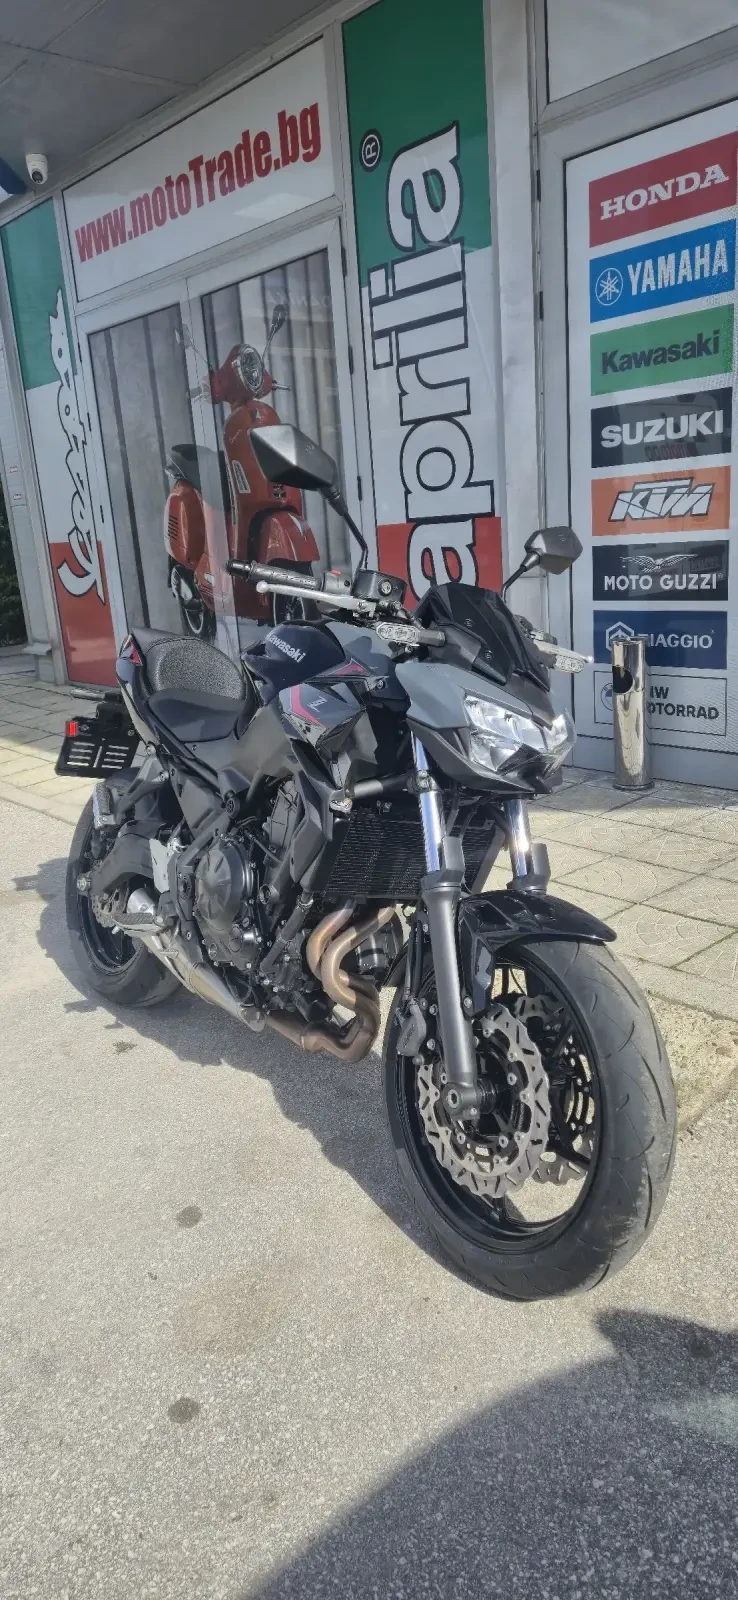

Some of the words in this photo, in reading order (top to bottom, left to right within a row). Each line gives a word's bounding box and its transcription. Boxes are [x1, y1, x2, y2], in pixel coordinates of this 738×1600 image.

[74, 102, 321, 263] www.motoTrade.bg
[600, 164, 729, 220] HONDA
[627, 239, 728, 295] YAMAHA
[368, 119, 494, 602] aprilia
[602, 329, 719, 374] Kawasaki
[601, 410, 723, 448] SUZUKI
[608, 477, 715, 522] KTM
[604, 575, 652, 590] MOTO
[660, 574, 717, 590] GUZZI
[265, 630, 306, 663] Kawasaki
[647, 702, 719, 719] OTORRAD
